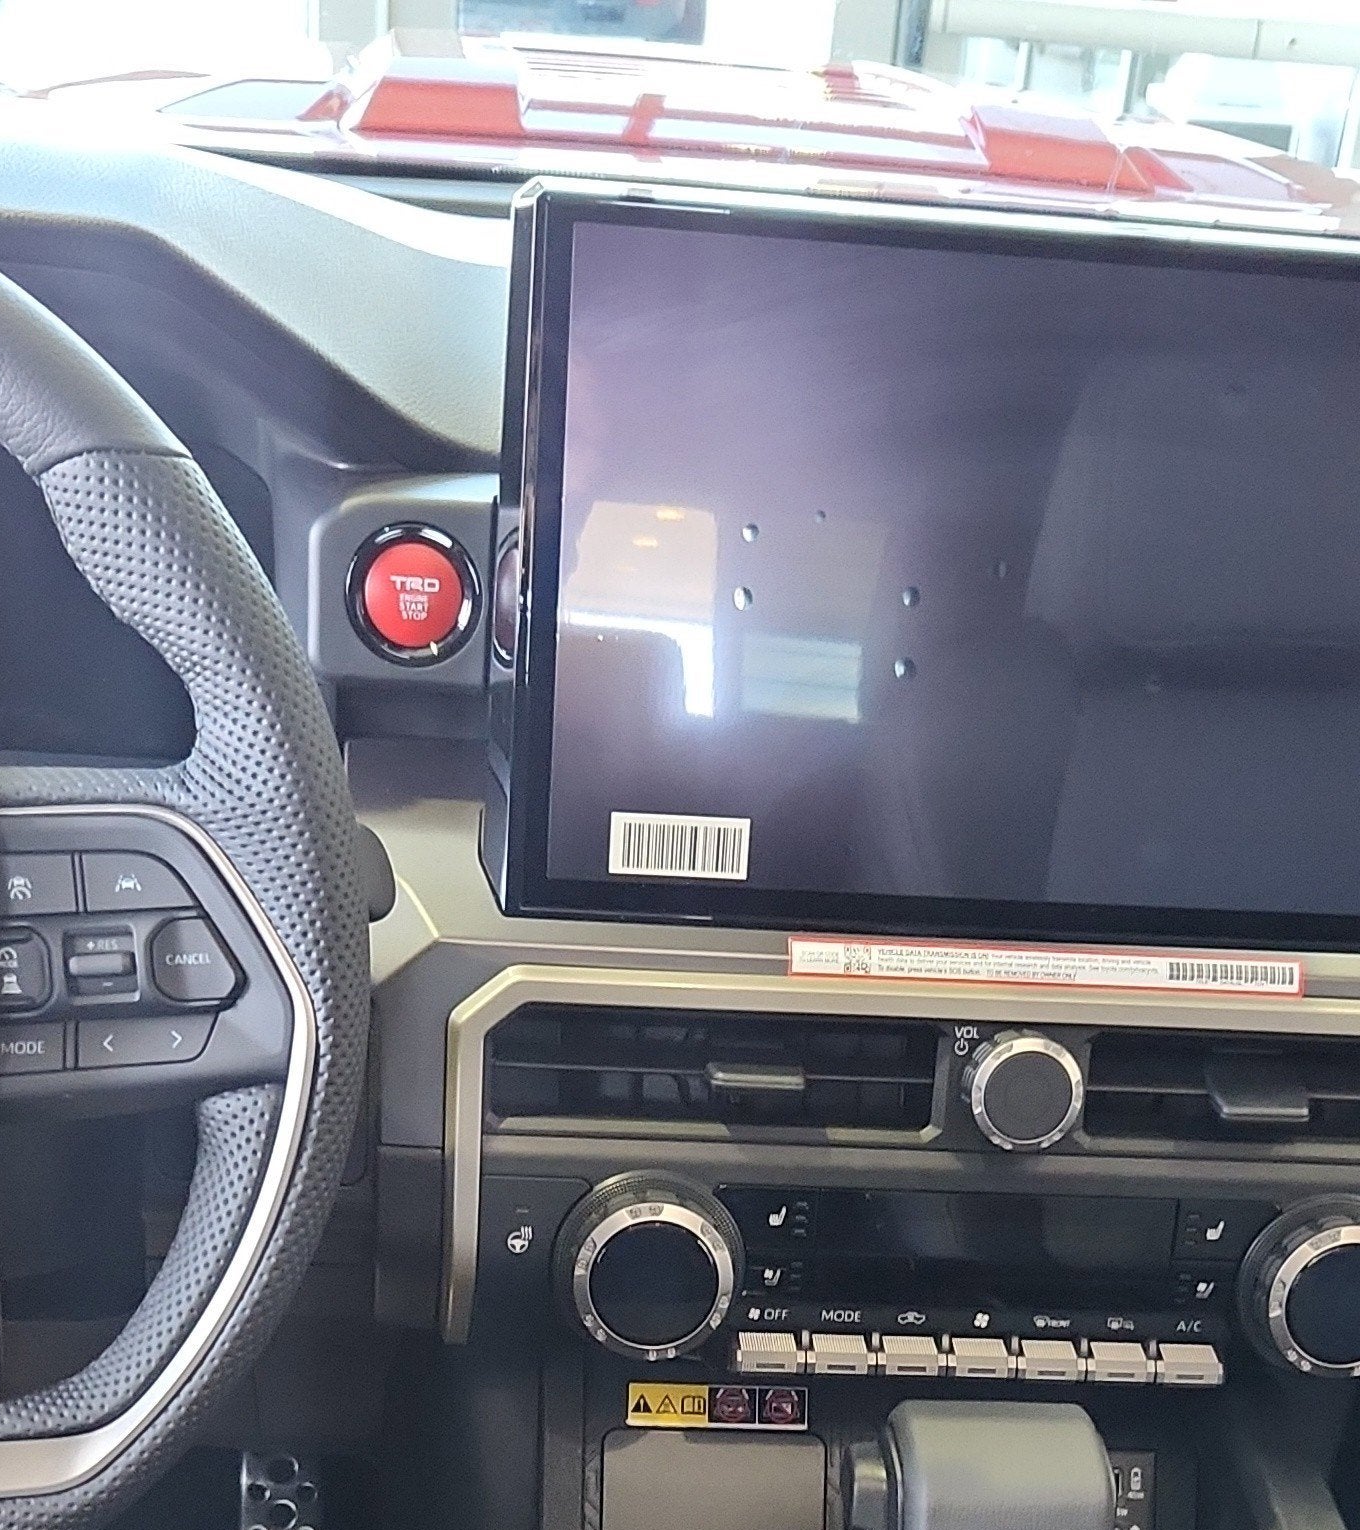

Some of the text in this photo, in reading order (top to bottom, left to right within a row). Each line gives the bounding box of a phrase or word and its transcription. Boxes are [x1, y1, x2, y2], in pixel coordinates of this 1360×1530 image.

[389, 575, 440, 593] TRD
[400, 601, 429, 612] START
[402, 611, 428, 620] STOP
[165, 952, 212, 966] CANCEL
[954, 1026, 980, 1039] VOL
[1, 1041, 45, 1055] MODE
[764, 1308, 790, 1321] OFF
[821, 1309, 862, 1323] MODE
[1176, 1320, 1203, 1333] A/C
